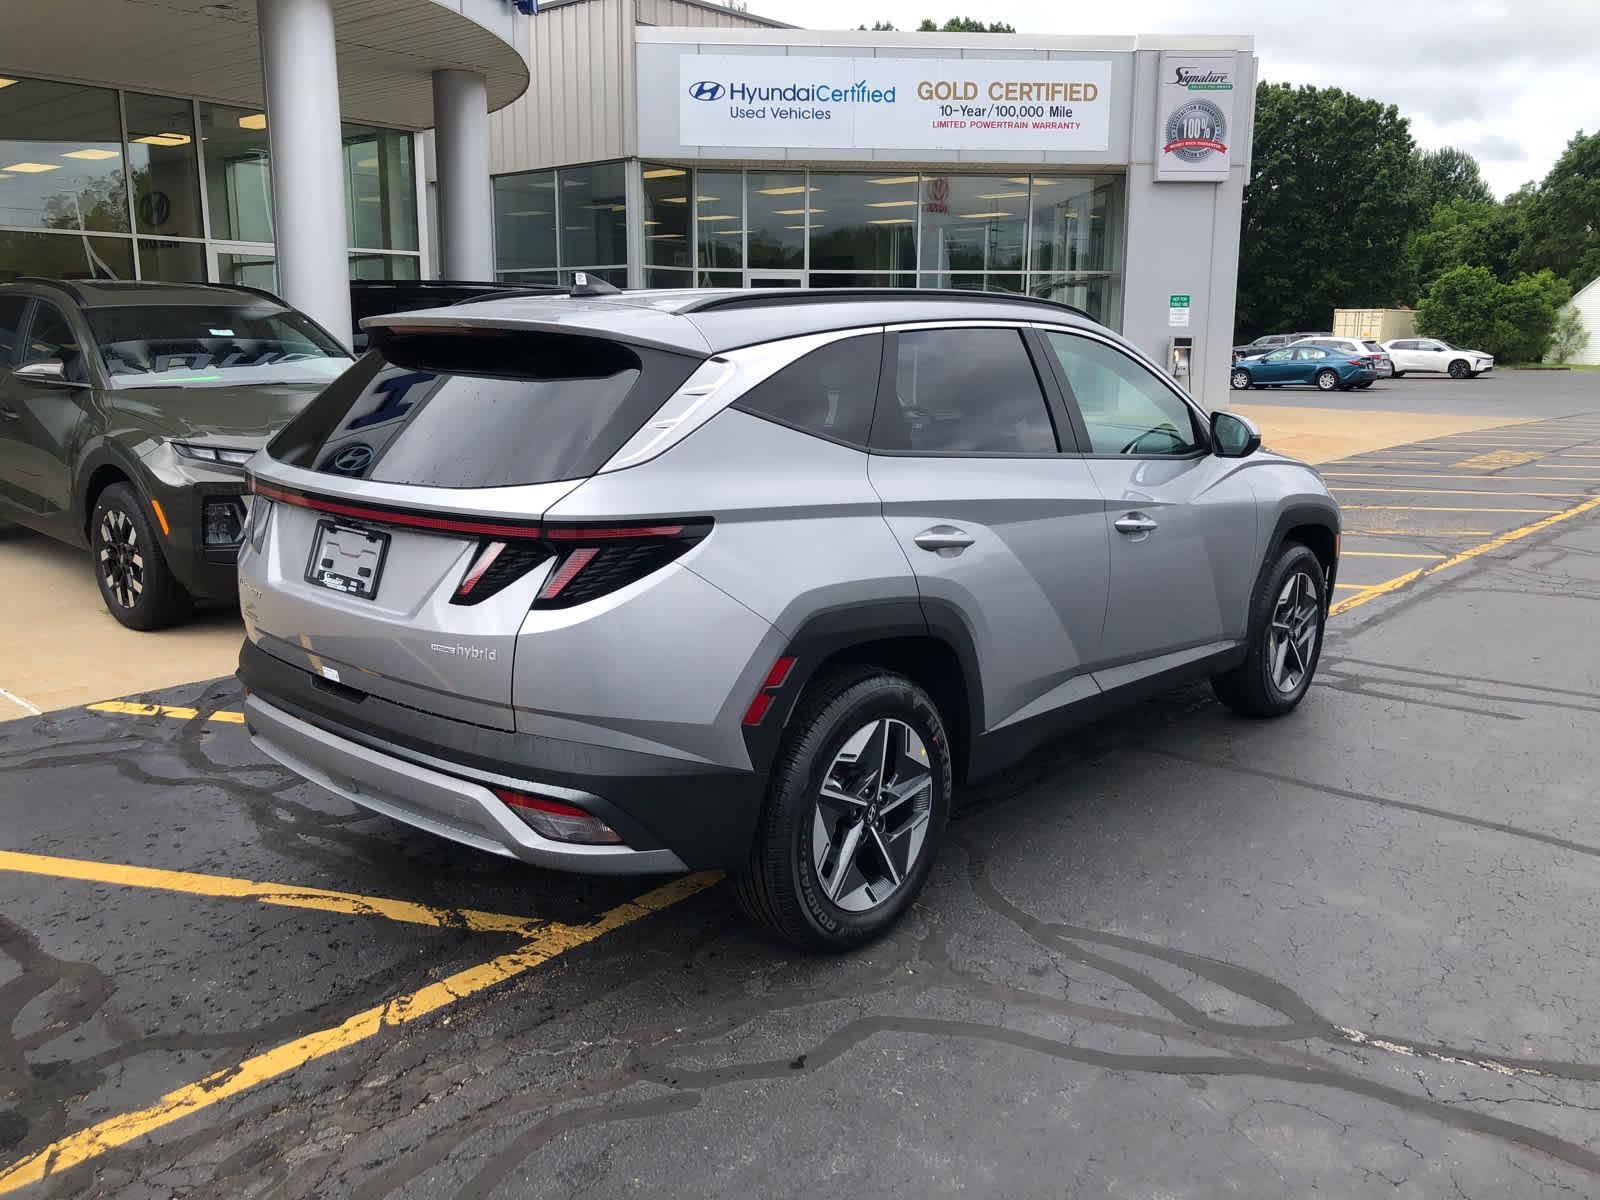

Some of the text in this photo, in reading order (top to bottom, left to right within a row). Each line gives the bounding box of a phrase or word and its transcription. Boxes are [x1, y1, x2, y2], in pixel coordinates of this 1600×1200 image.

[1165, 67, 1232, 87] Signature
[917, 81, 1098, 102] GOLD CERTIFIED
[730, 106, 831, 120] Used Vehicles
[939, 104, 1073, 119] 10-Year/100,000 Mile
[932, 121, 1081, 130] LIMITED POWERTRAIN WARRANTY
[1183, 118, 1211, 139] 100%
[456, 643, 497, 661] hybrid
